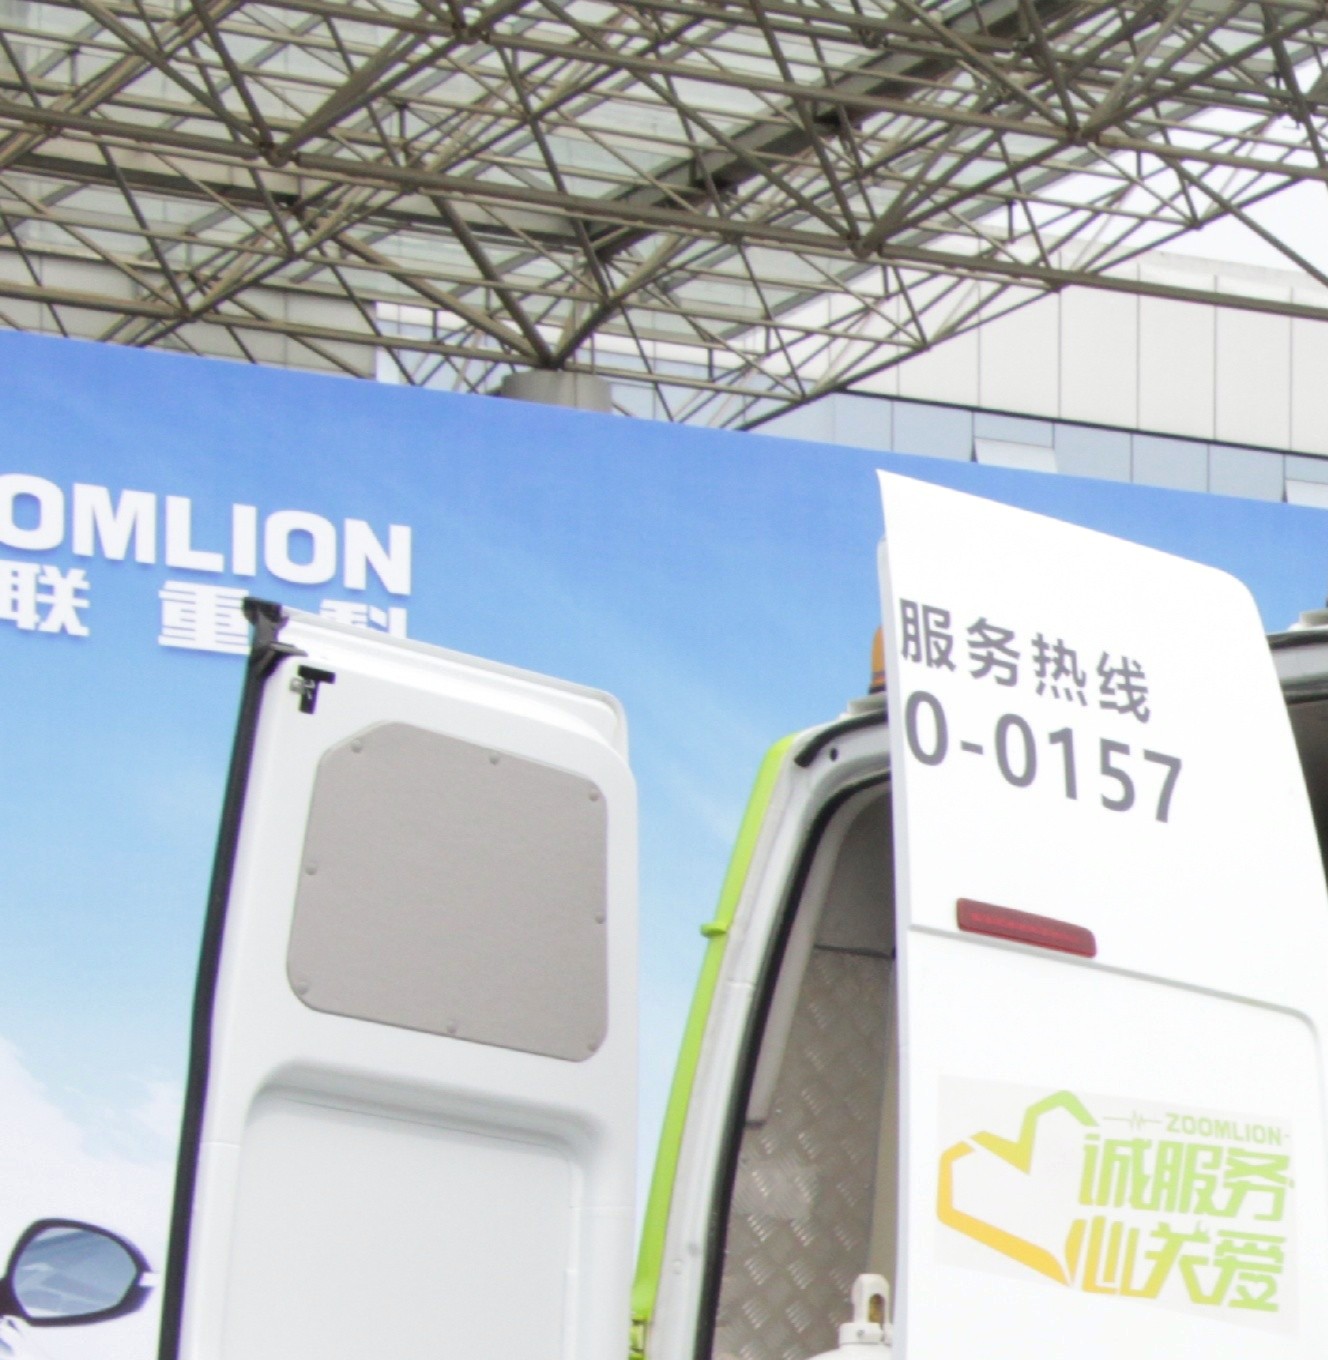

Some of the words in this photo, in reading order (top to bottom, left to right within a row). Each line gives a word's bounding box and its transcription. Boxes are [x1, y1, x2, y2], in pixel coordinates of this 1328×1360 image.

[0, 473, 412, 595] OMLION
[900, 598, 1150, 723] 服务热线
[904, 690, 1183, 824] 0-0157
[1166, 1113, 1283, 1147] ZOOMLION
